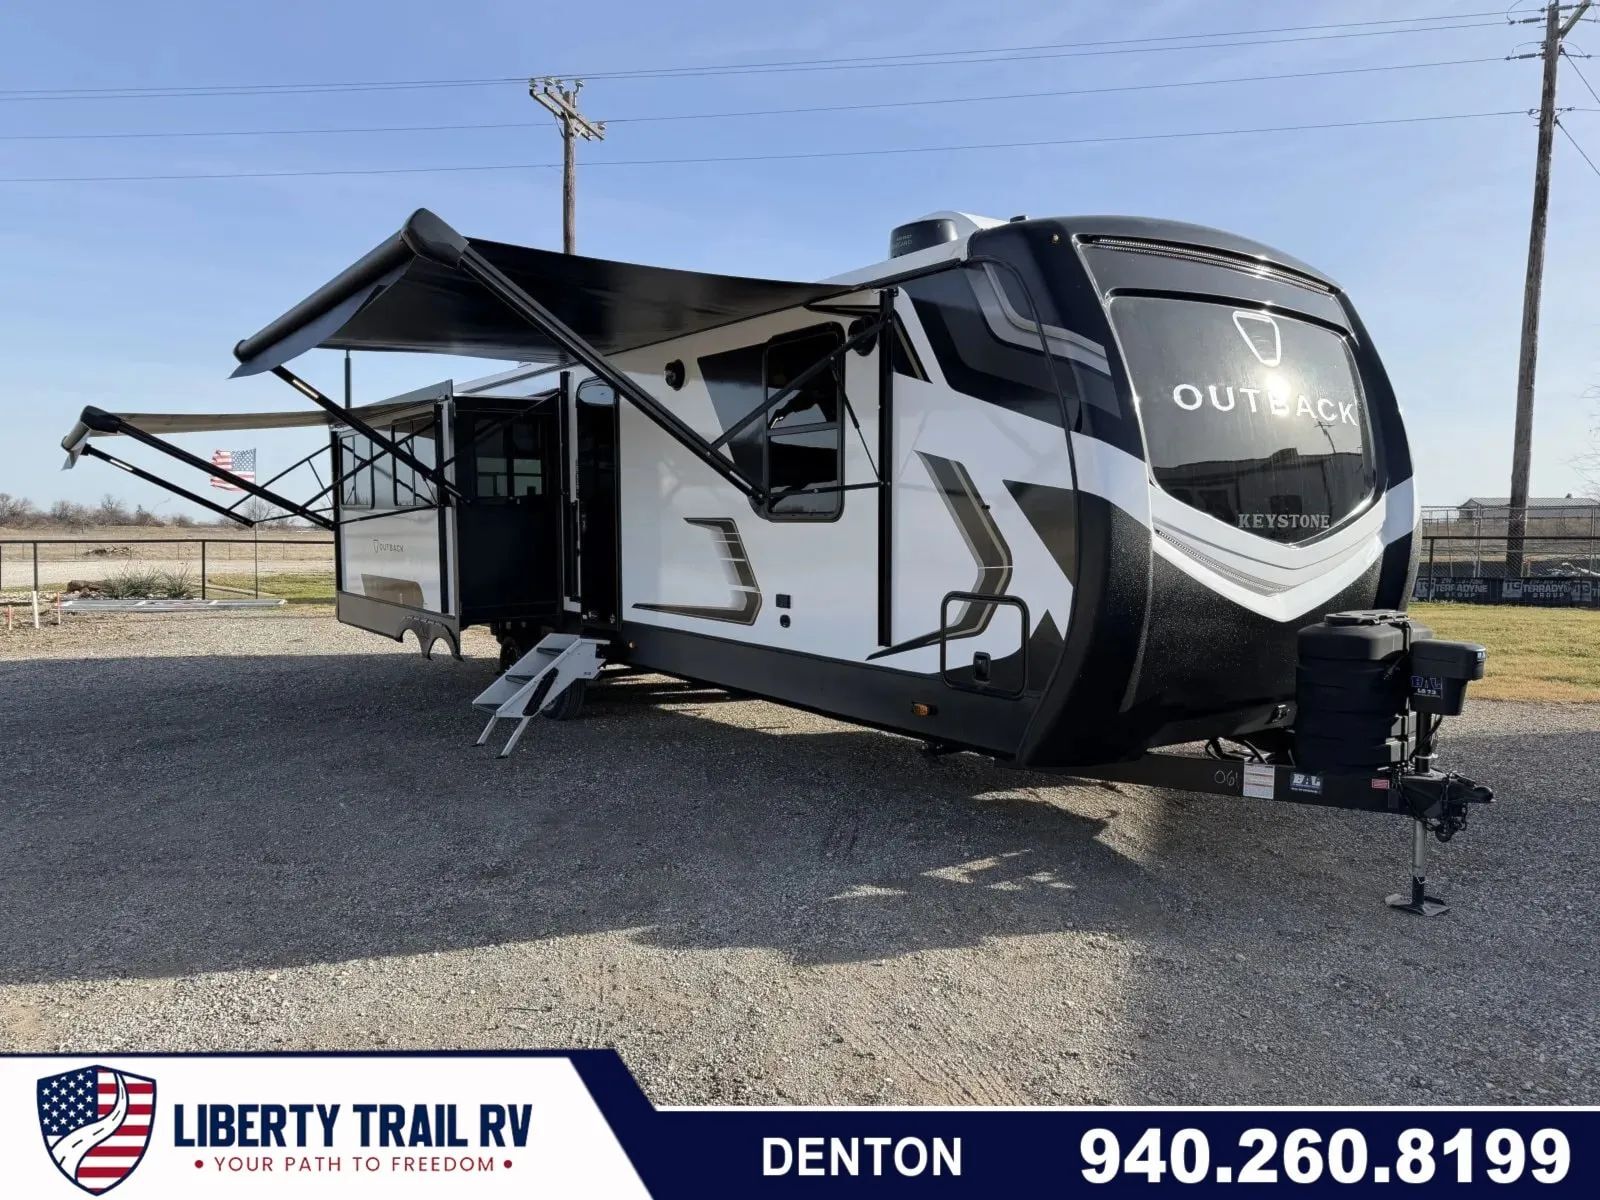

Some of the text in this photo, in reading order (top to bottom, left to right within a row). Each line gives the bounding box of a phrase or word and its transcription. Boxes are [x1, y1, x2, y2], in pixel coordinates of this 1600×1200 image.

[1173, 383, 1358, 426] OUTBACK
[1238, 513, 1331, 529] KEYSTONE
[379, 543, 404, 553] OUTBACK
[1522, 584, 1571, 593] TERRADY
